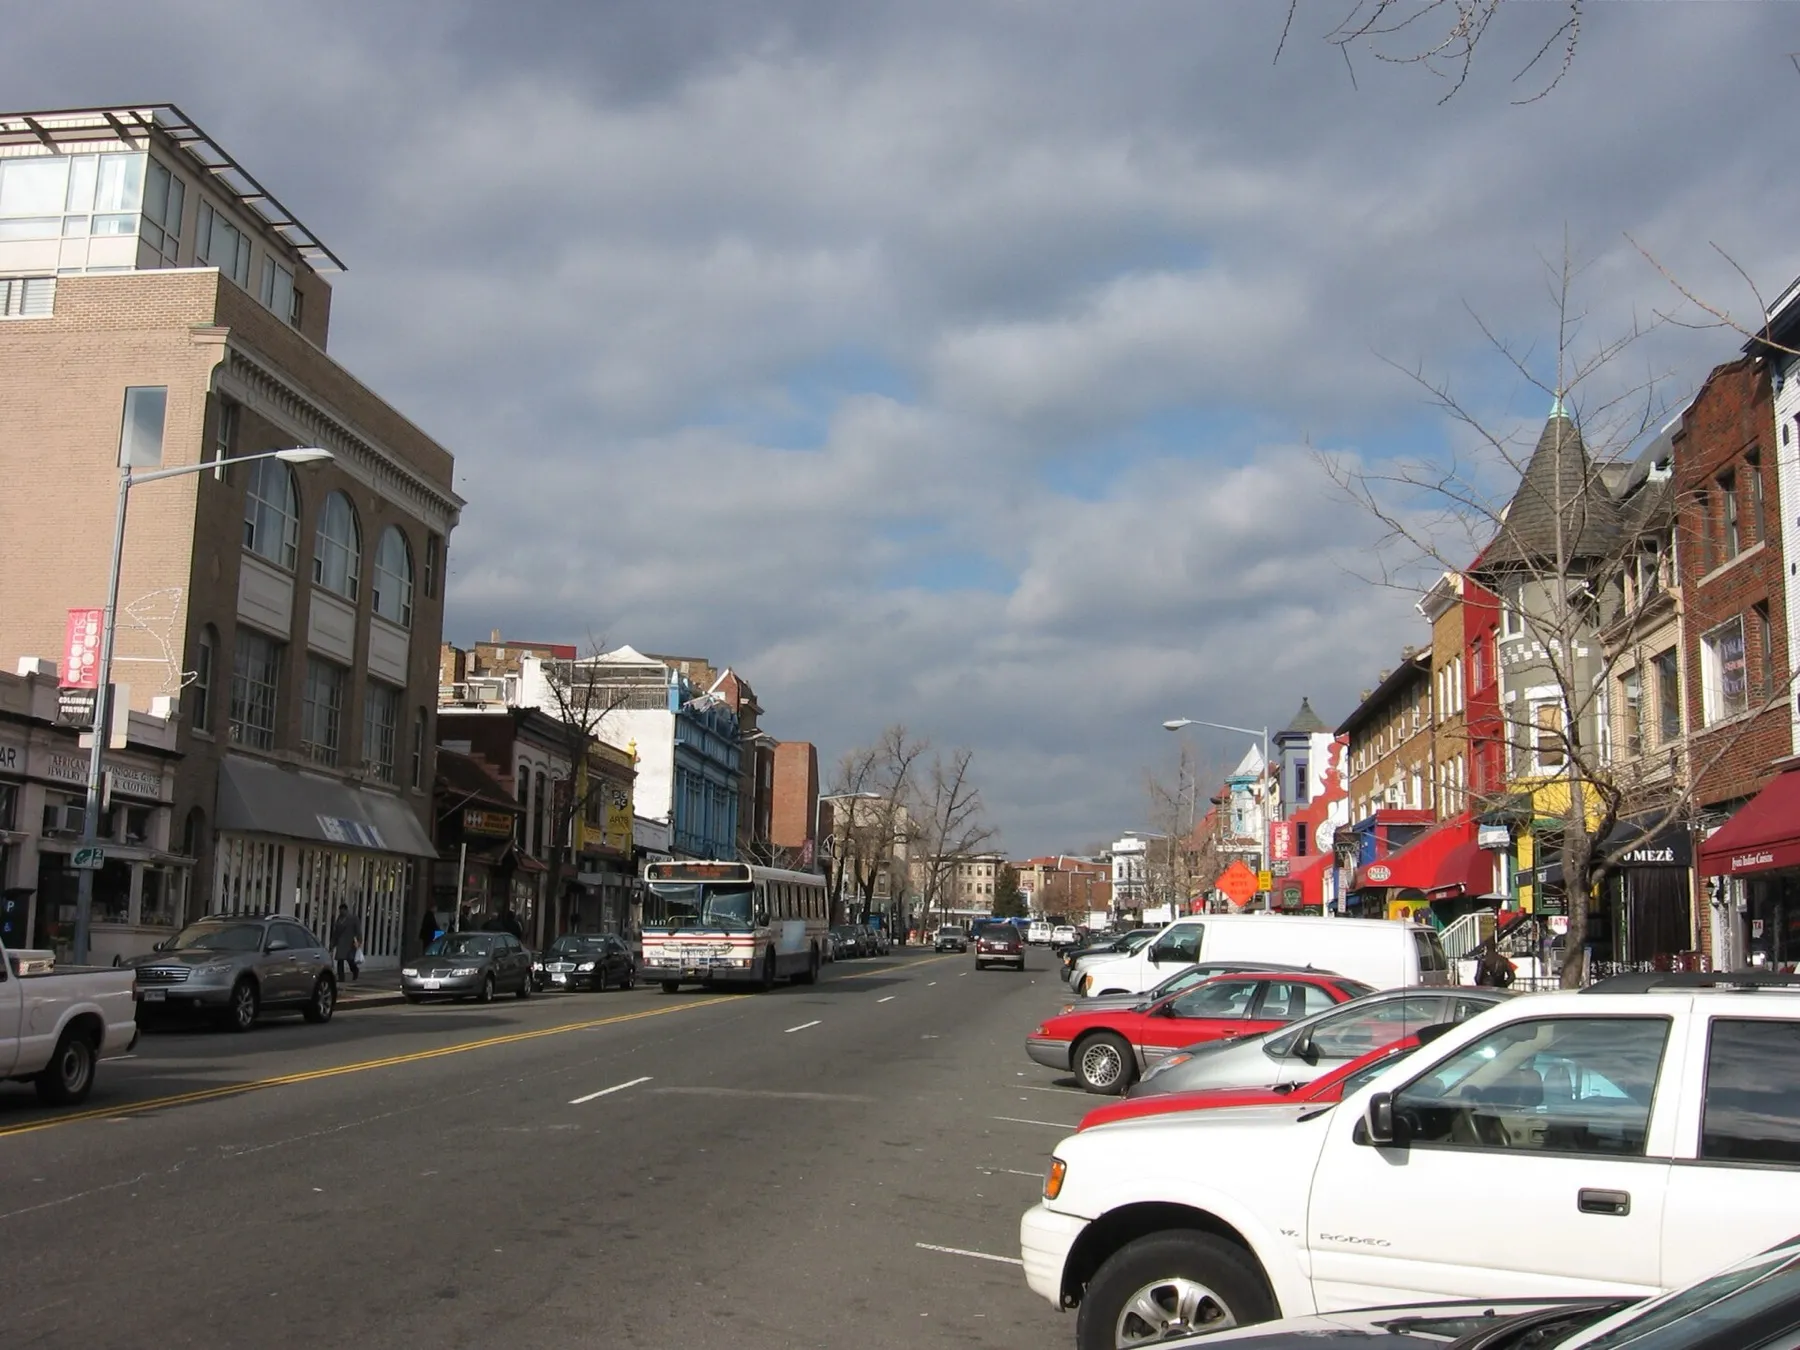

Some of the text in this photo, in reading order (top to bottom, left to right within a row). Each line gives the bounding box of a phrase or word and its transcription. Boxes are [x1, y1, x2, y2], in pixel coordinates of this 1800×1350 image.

[67, 619, 87, 683] adams
[80, 610, 100, 684] morgan
[59, 696, 94, 706] COLUMBIA
[61, 705, 90, 714] STATION
[52, 754, 86, 771] AFRICAN
[122, 780, 159, 797] CLOTHING
[1633, 847, 1675, 862] MEZÈ
[1319, 1232, 1391, 1248] RODEO
